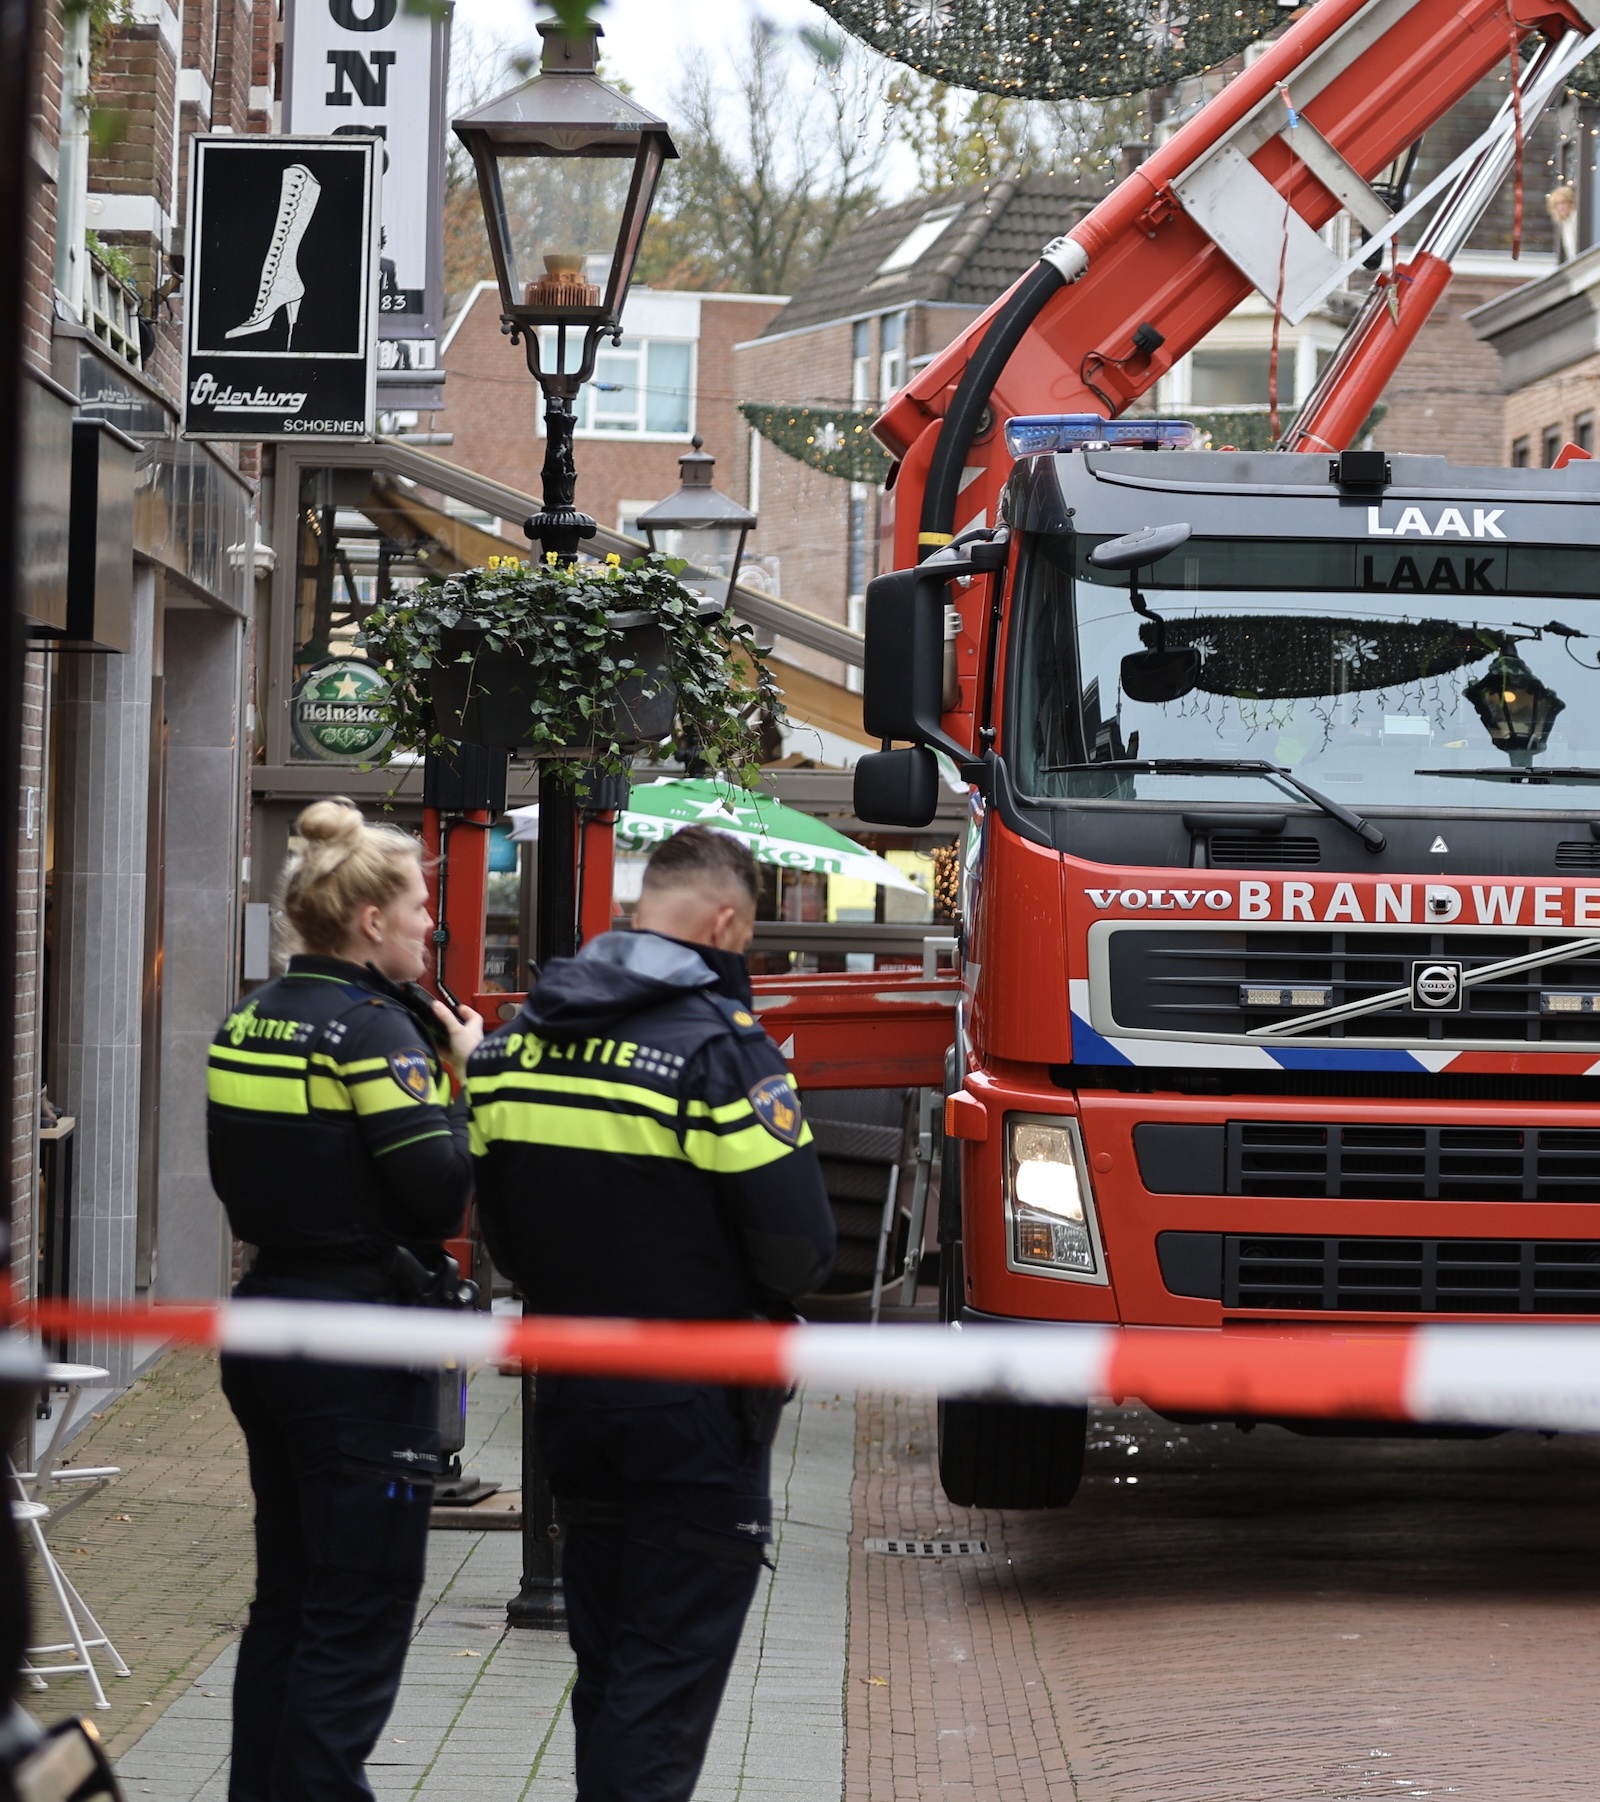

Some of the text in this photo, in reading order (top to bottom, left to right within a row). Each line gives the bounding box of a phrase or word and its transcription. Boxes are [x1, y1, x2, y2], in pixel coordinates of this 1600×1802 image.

[190, 373, 307, 413] Oldenburg
[283, 418, 364, 432] SCHOENEN
[1367, 506, 1508, 538] LAAK
[1363, 555, 1496, 591] LAAK
[303, 703, 386, 723] Heineke
[1084, 889, 1233, 910] VOLVO
[506, 1032, 638, 1070] POLITIE
